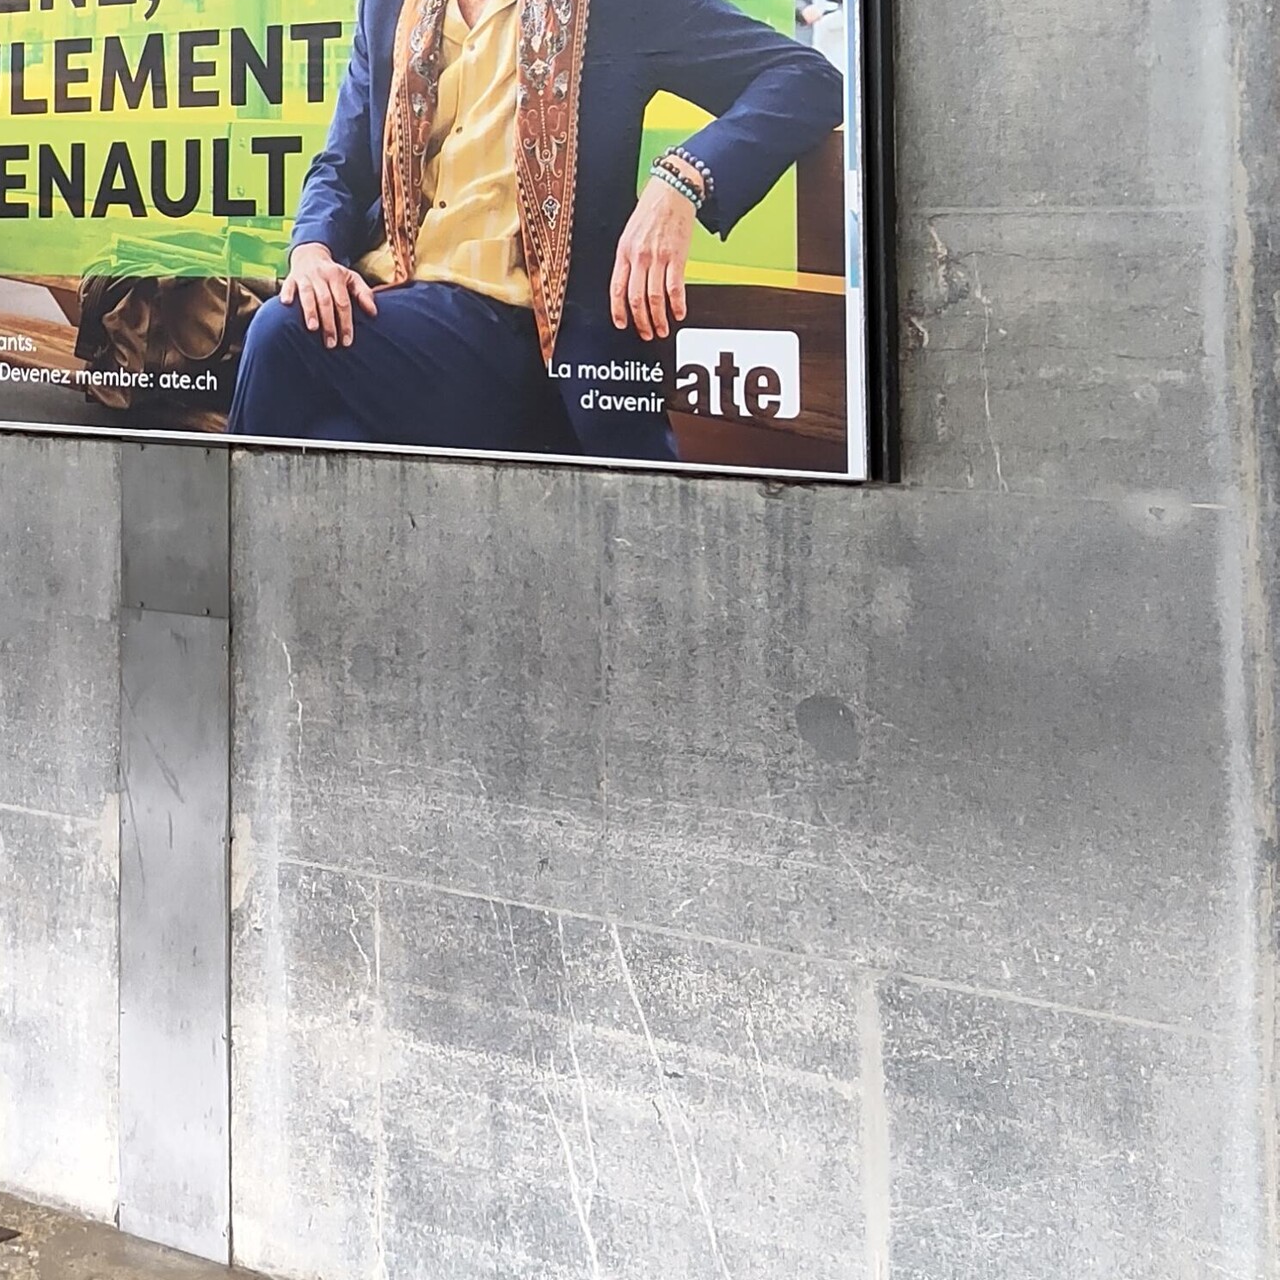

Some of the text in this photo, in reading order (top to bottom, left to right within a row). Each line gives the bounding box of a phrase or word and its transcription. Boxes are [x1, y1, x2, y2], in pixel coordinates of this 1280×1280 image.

[75, 365, 155, 388] membre:
[158, 369, 218, 391] ate.ch
[547, 358, 665, 383] La mobilité
[674, 351, 782, 419] ate
[579, 389, 665, 413] d'avenir
